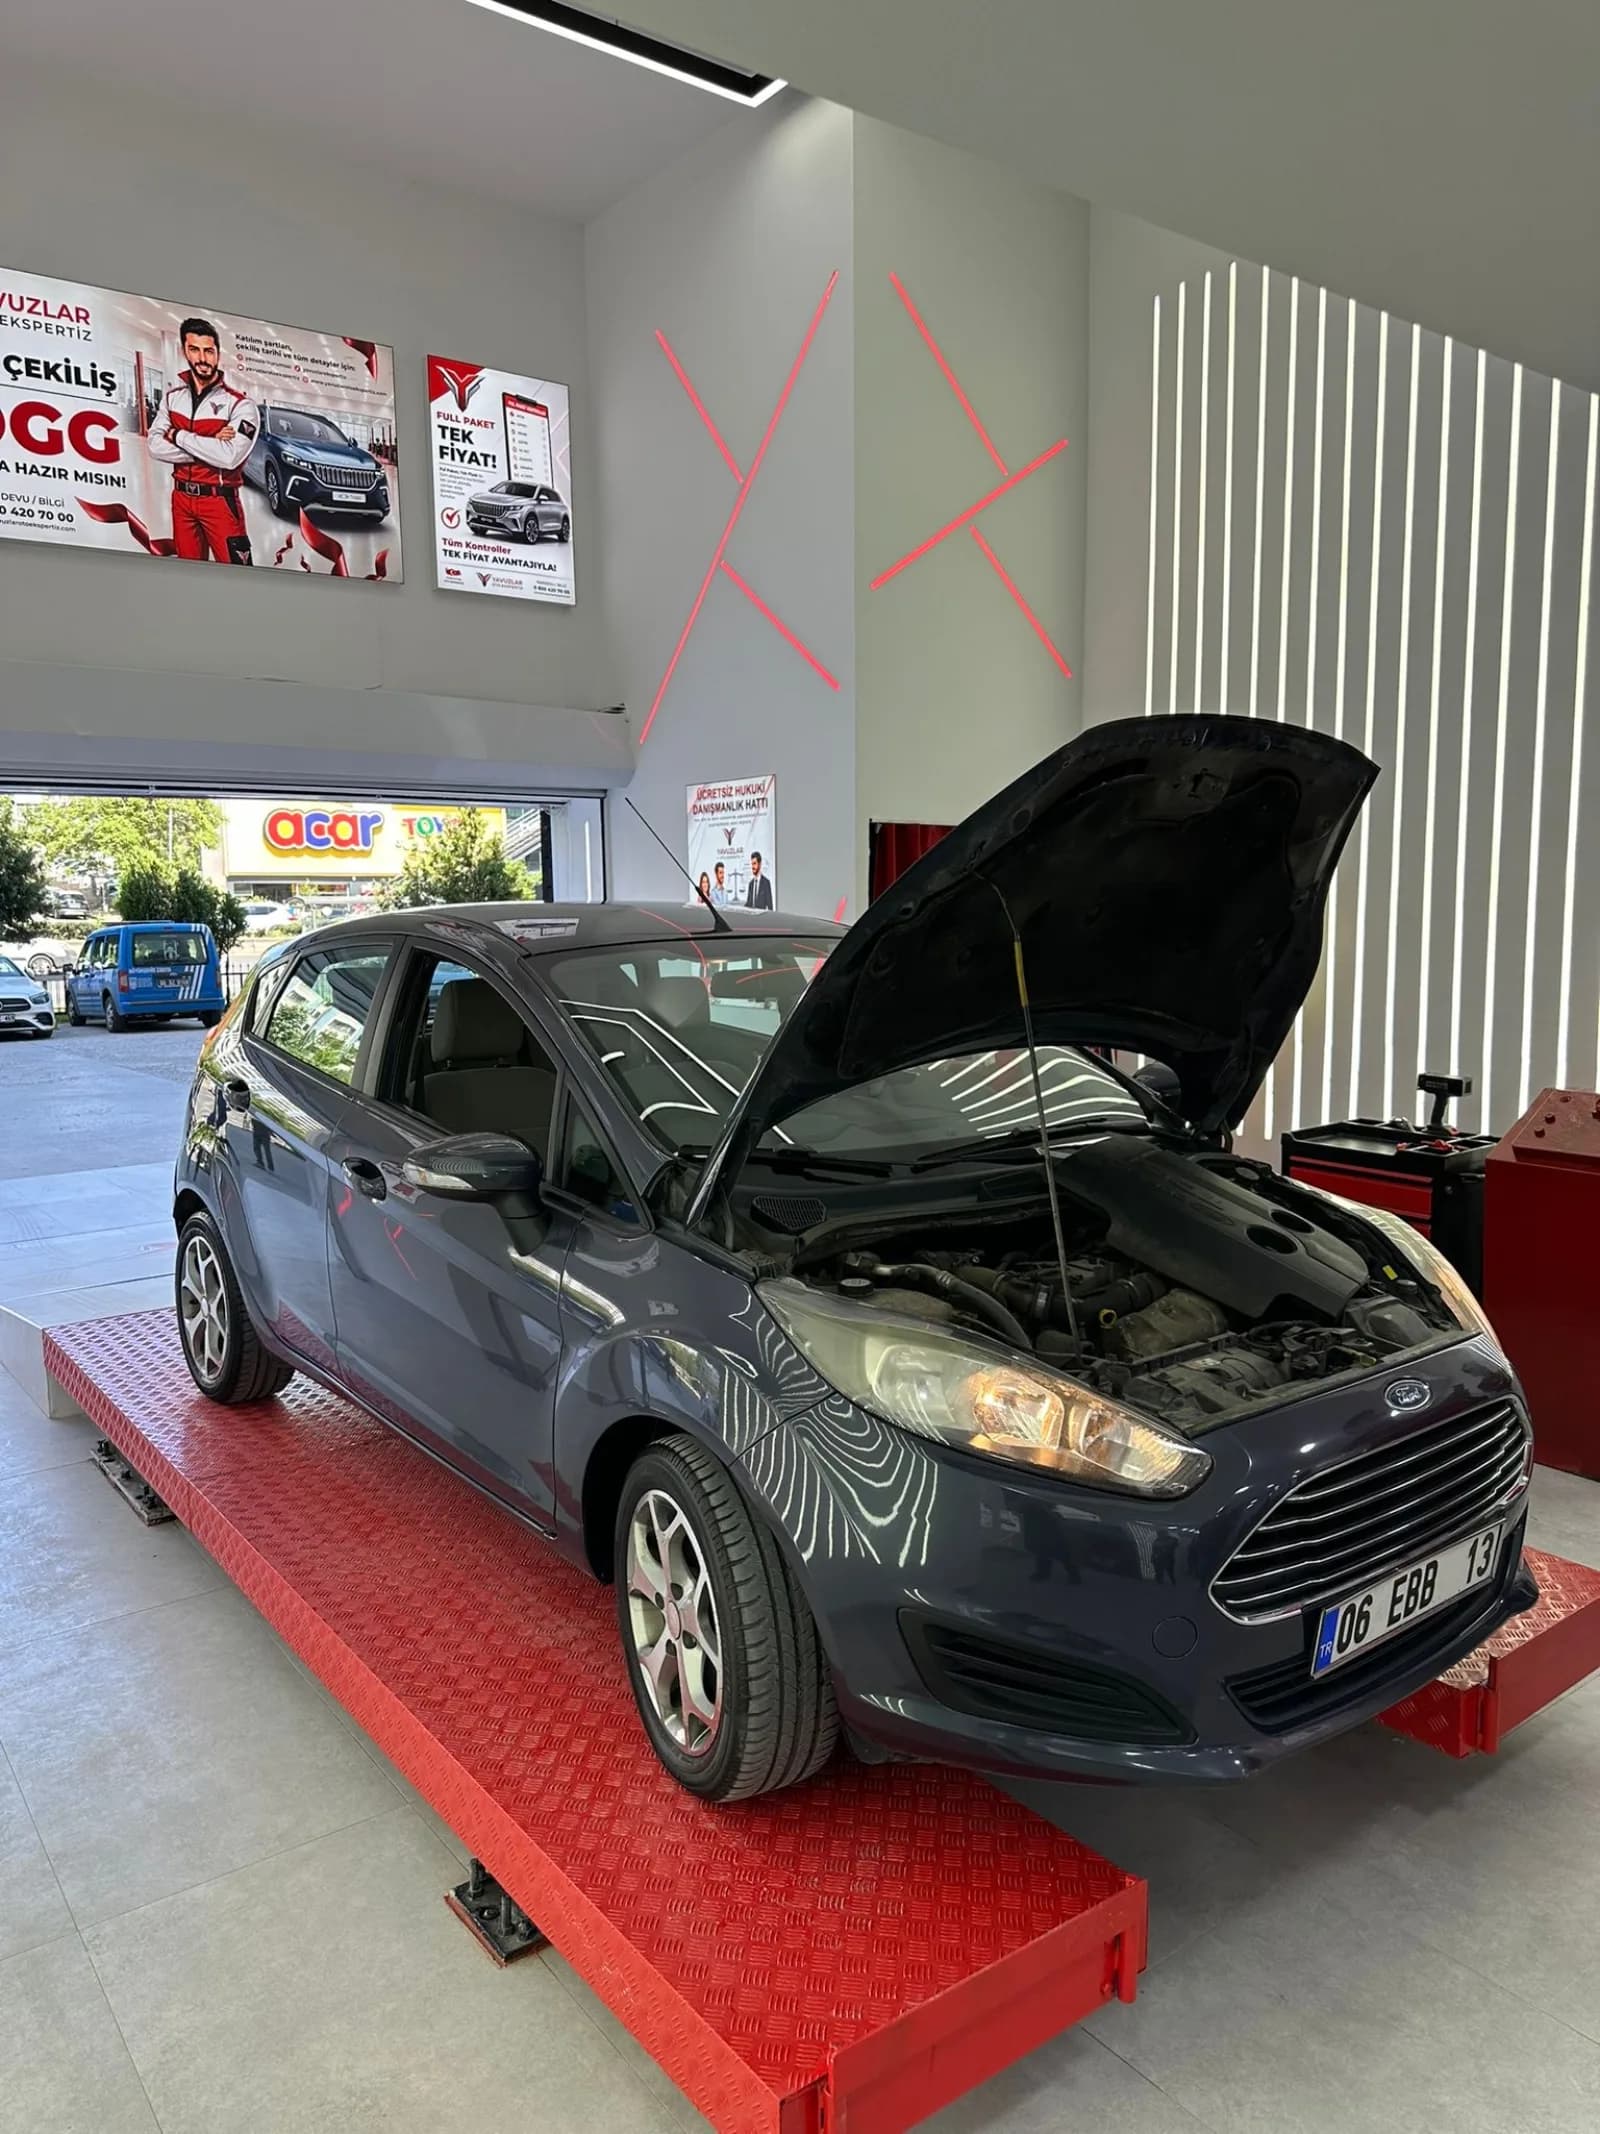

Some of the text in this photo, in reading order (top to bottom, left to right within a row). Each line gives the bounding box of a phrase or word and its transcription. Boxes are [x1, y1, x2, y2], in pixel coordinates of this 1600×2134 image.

[0, 315, 92, 341] EKSPERTİZ
[262, 348, 281, 357] tarihi
[294, 354, 308, 362] tüm
[310, 357, 339, 368] detaylar
[3, 355, 117, 396] ÇEKİLİŞ
[437, 411, 495, 429] FULL PAKET
[0, 401, 120, 464] GG
[437, 425, 474, 445] TEK
[439, 442, 496, 469] FİYAT!
[15, 462, 69, 480] HAZIR
[74, 470, 126, 488] MISIN!
[39, 497, 64, 507] BİLGİ
[11, 507, 35, 517] 420
[38, 510, 54, 520] 70
[57, 513, 74, 523] 00
[442, 537, 512, 554] Tüm Kontroller
[443, 549, 557, 572] TEK FİYAT AVANTAJIYLA!
[696, 781, 765, 800] ÜCRETSİZ HUKUKİ
[692, 797, 768, 816] DANIŞMANLIK HATTI
[266, 810, 382, 850] acar
[1395, 1386, 1422, 1404] Ford
[1336, 1532, 1495, 1654] 06 EBB 13
[1320, 1641, 1332, 1658] TR
